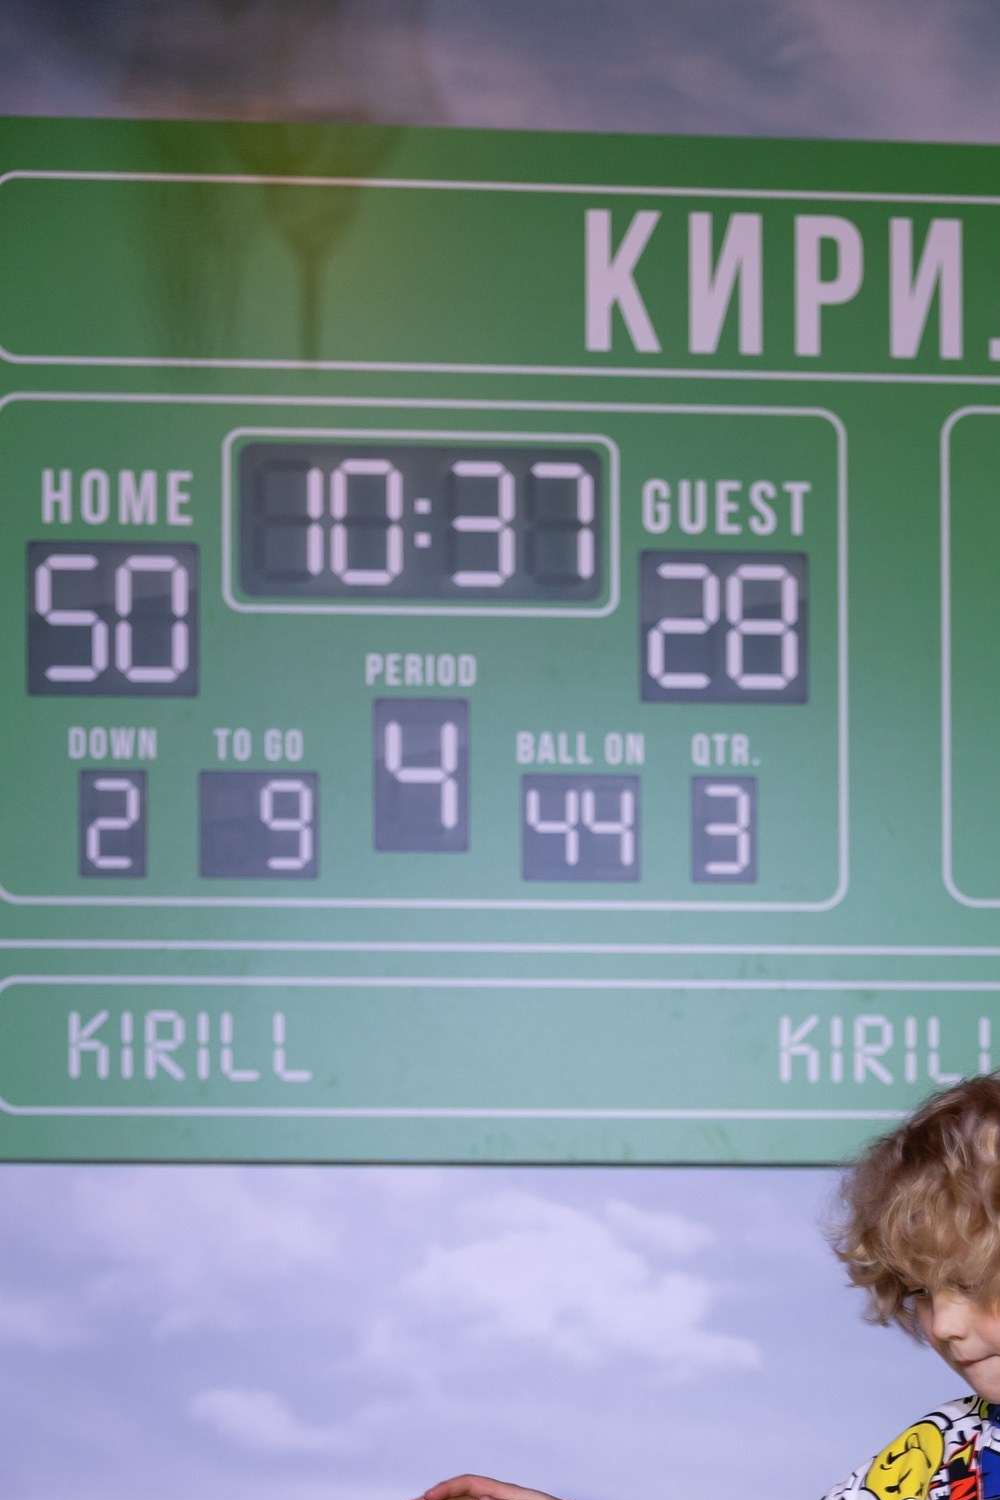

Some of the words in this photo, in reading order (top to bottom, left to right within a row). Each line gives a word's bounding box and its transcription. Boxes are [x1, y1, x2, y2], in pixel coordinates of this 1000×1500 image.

[42, 468, 193, 526] HOME
[306, 458, 594, 587] 10:37
[642, 478, 811, 536] GUEST
[35, 554, 189, 683] 50
[648, 563, 798, 690] 28
[365, 653, 477, 687] PERIOD
[68, 727, 157, 760] DOWN
[213, 727, 253, 761] TO
[264, 728, 304, 762] GO
[385, 722, 458, 829] 4
[516, 731, 593, 765] BALL
[604, 732, 645, 765] ON
[691, 732, 760, 767] QTR.
[87, 778, 140, 869] 2
[259, 779, 313, 870] 9
[527, 789, 634, 866] 44
[705, 785, 750, 875] 3
[69, 1010, 314, 1083] KIRILL
